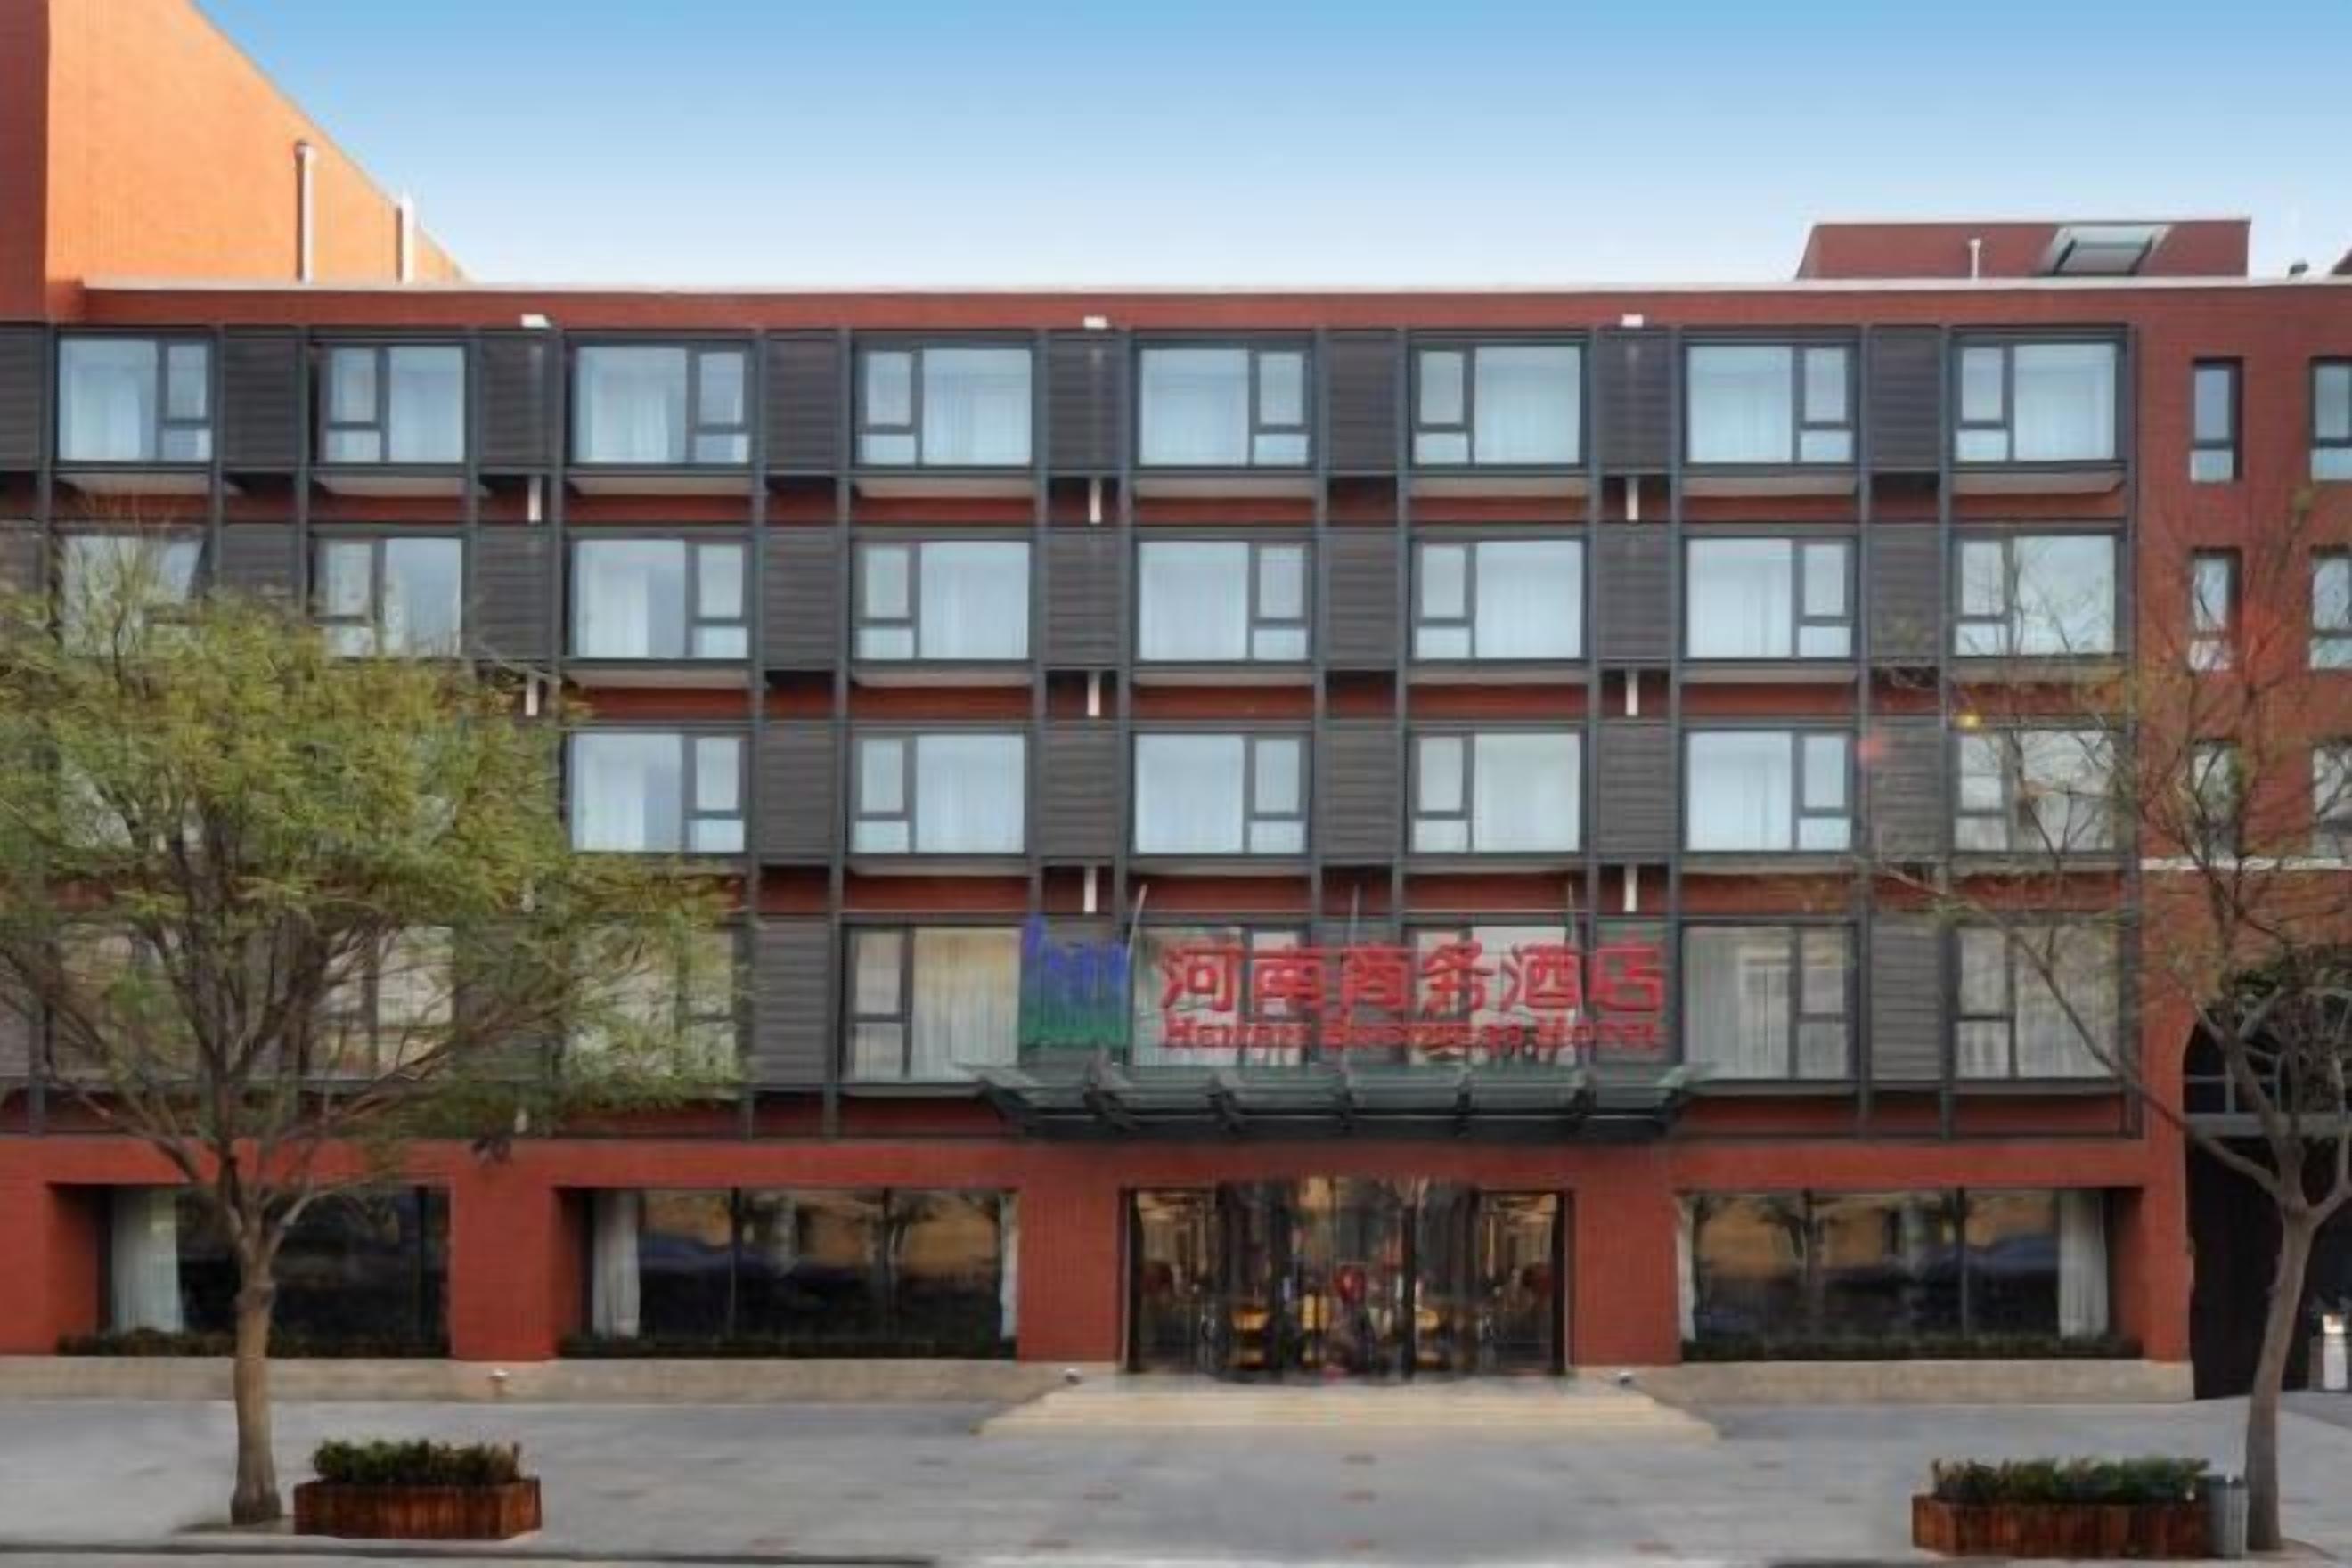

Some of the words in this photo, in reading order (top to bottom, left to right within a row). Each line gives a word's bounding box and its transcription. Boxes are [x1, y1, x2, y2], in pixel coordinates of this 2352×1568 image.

[1161, 938, 1664, 1013] 河南商务酒店
